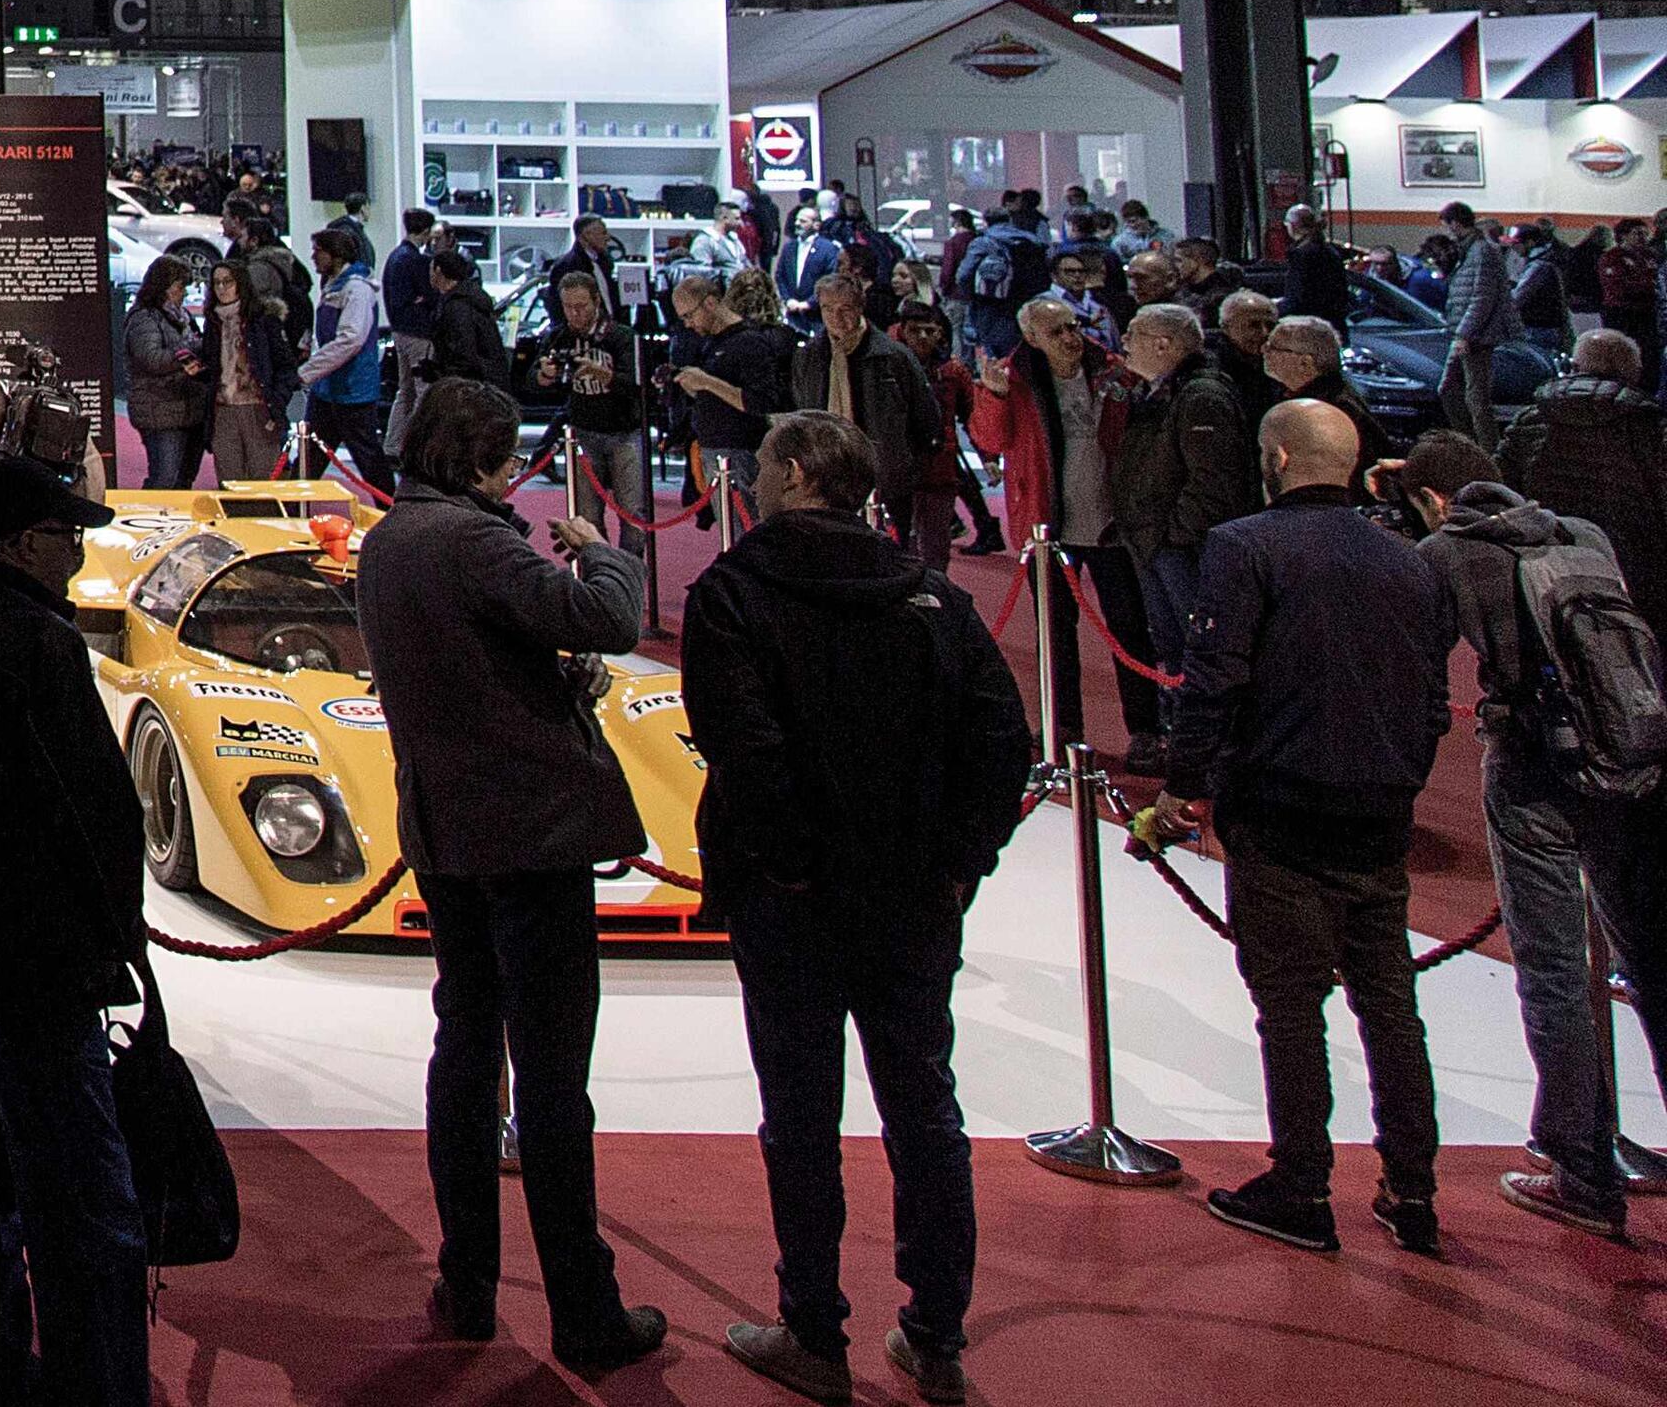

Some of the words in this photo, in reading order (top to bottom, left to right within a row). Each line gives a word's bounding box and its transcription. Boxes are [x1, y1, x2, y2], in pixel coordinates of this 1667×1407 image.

[36, 146, 74, 160] 512M
[194, 682, 299, 704] Fireston
[628, 694, 683, 715] Fire
[251, 748, 318, 766] MARCHAL
